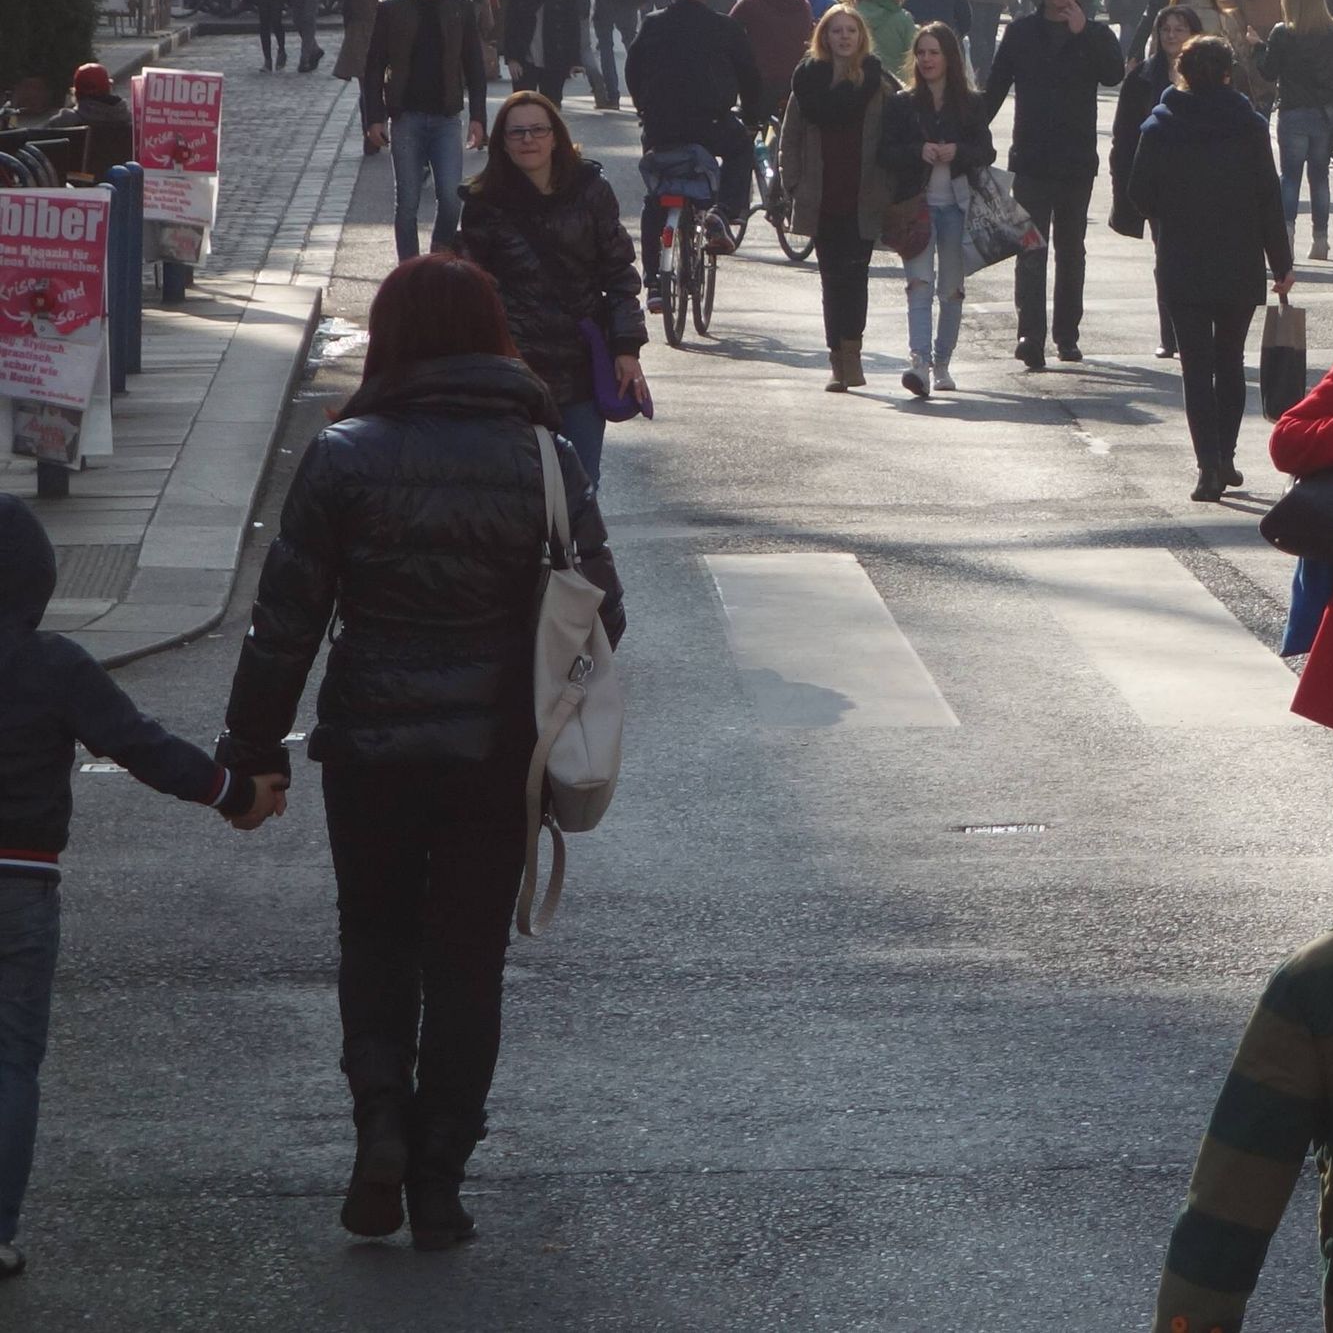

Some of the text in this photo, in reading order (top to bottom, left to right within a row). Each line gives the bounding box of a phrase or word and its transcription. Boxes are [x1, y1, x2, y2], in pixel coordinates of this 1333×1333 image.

[148, 73, 220, 106] biber
[0, 195, 104, 243] biber
[21, 244, 70, 260] Magazin
[72, 249, 89, 261] für
[57, 280, 86, 303] und
